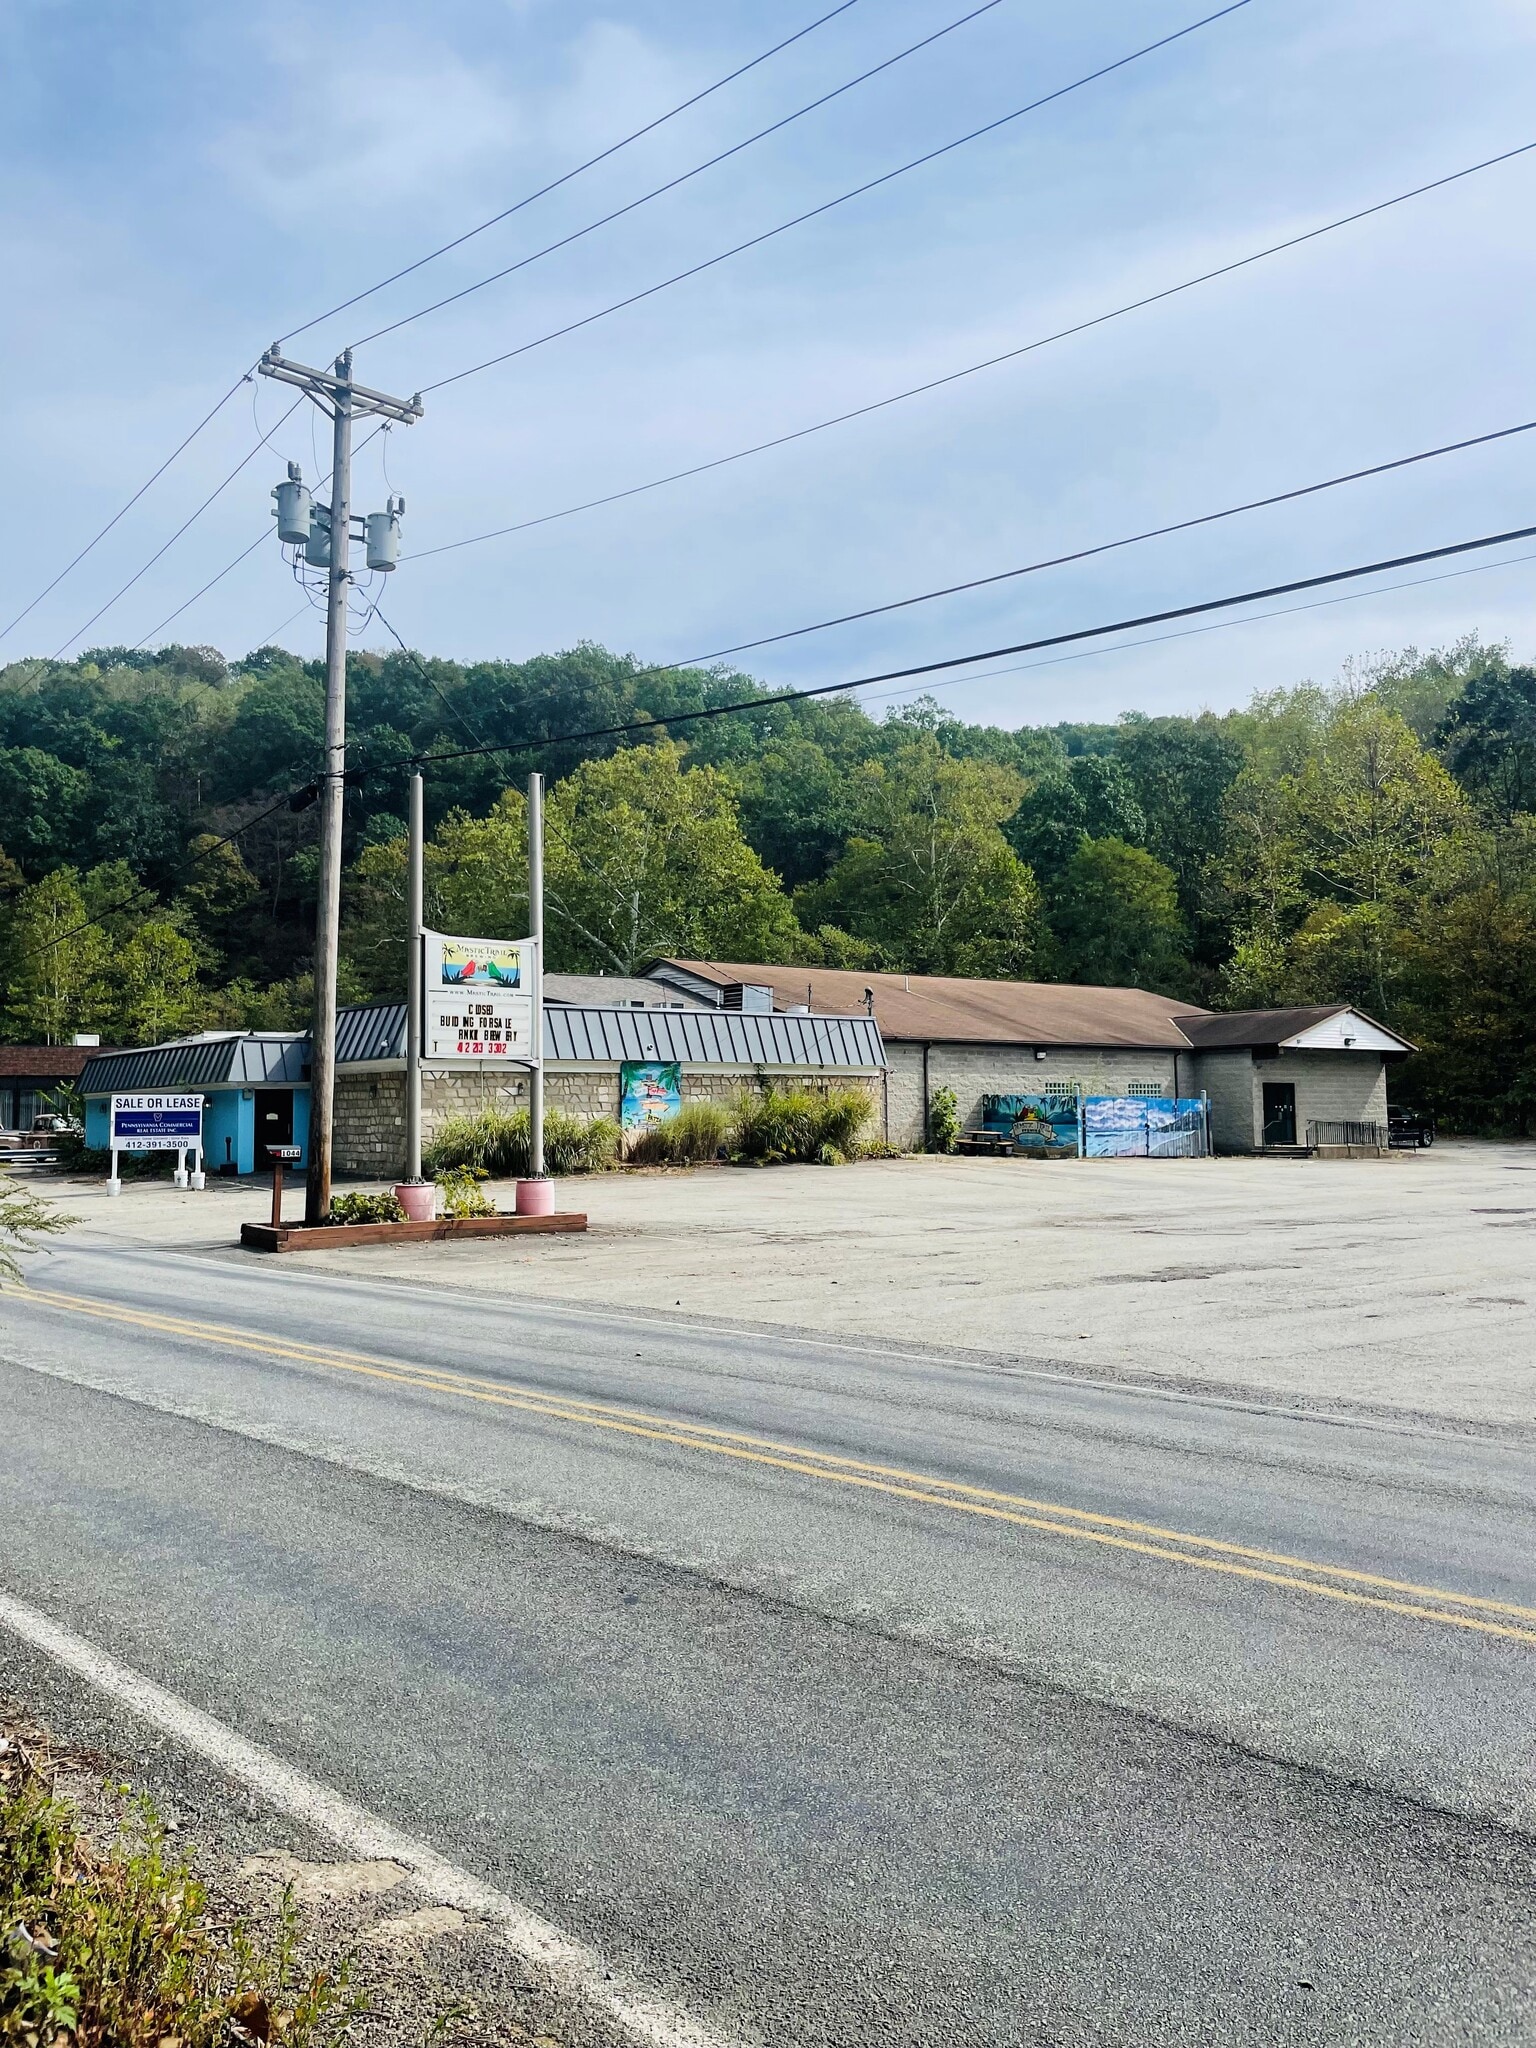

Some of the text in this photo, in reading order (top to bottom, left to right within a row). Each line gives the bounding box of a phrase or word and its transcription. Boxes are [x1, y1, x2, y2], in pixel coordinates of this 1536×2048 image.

[115, 1098, 200, 1108] SALE OR LEASE
[125, 1140, 189, 1149] 412-391-3500
